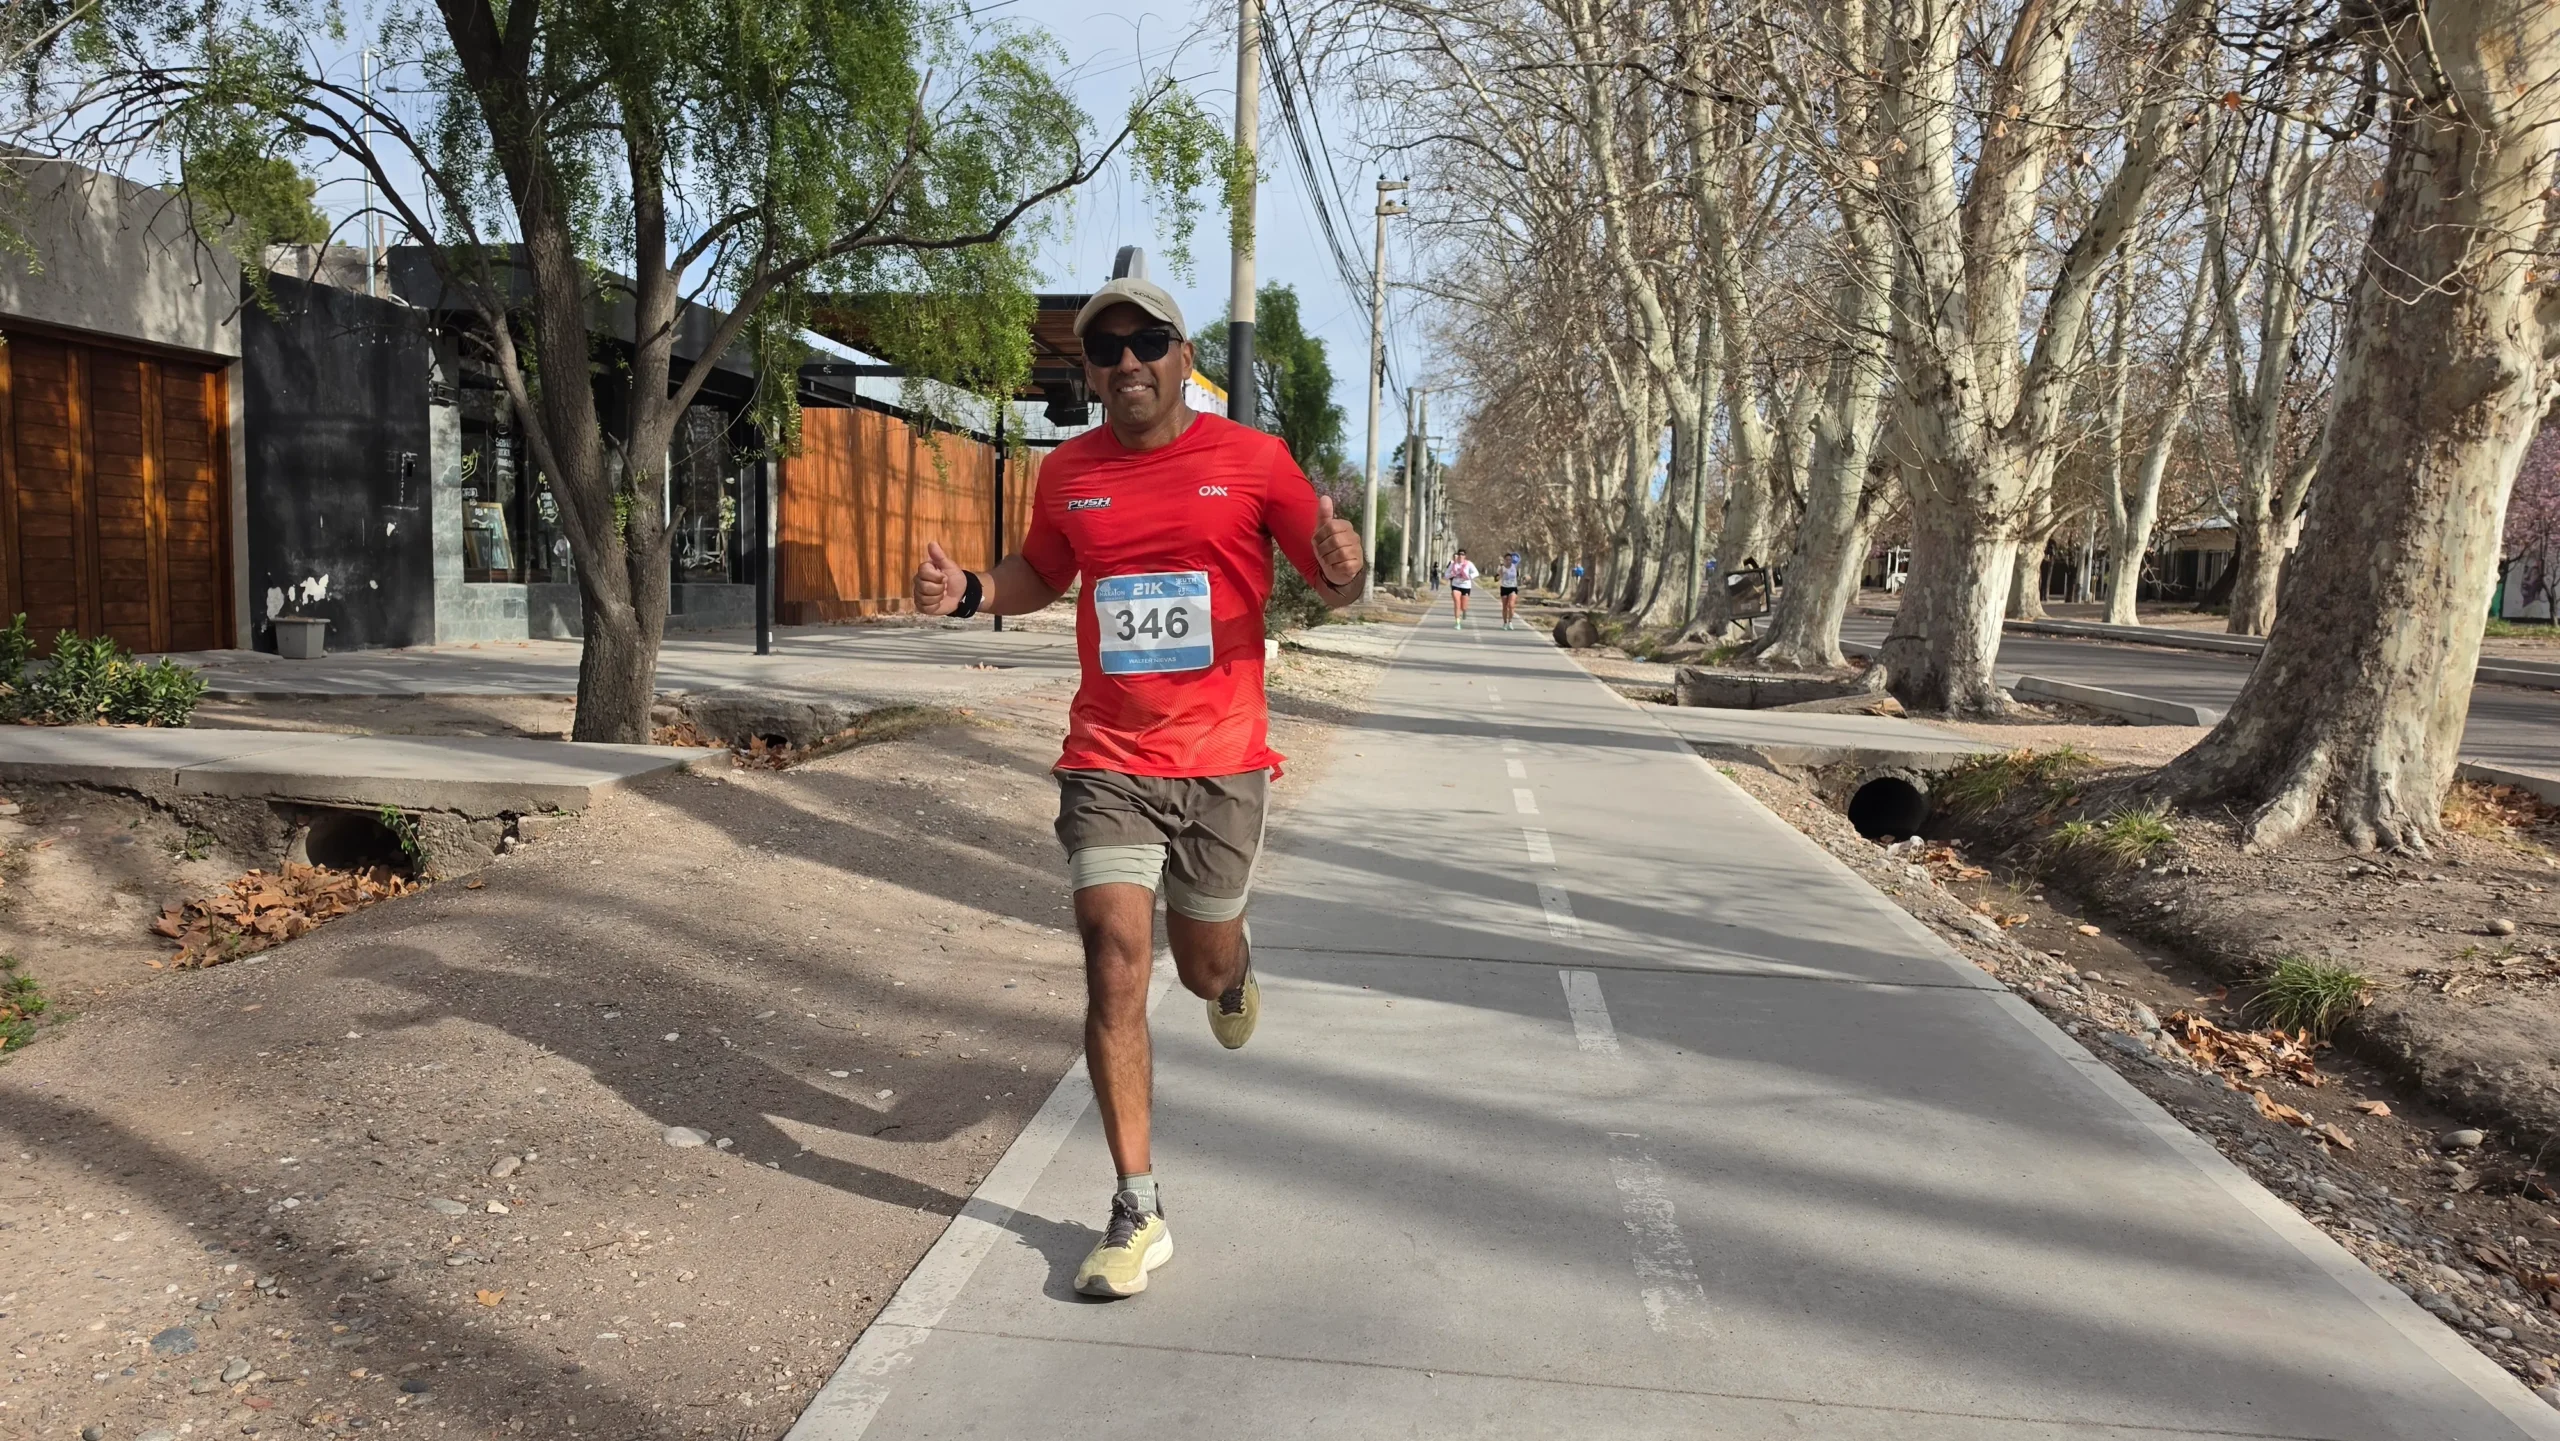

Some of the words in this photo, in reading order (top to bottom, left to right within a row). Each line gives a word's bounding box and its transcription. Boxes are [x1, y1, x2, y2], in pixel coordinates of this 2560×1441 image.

[1068, 497, 1111, 510] PUSH
[1133, 582, 1164, 596] 21K
[1116, 606, 1189, 642] 346
